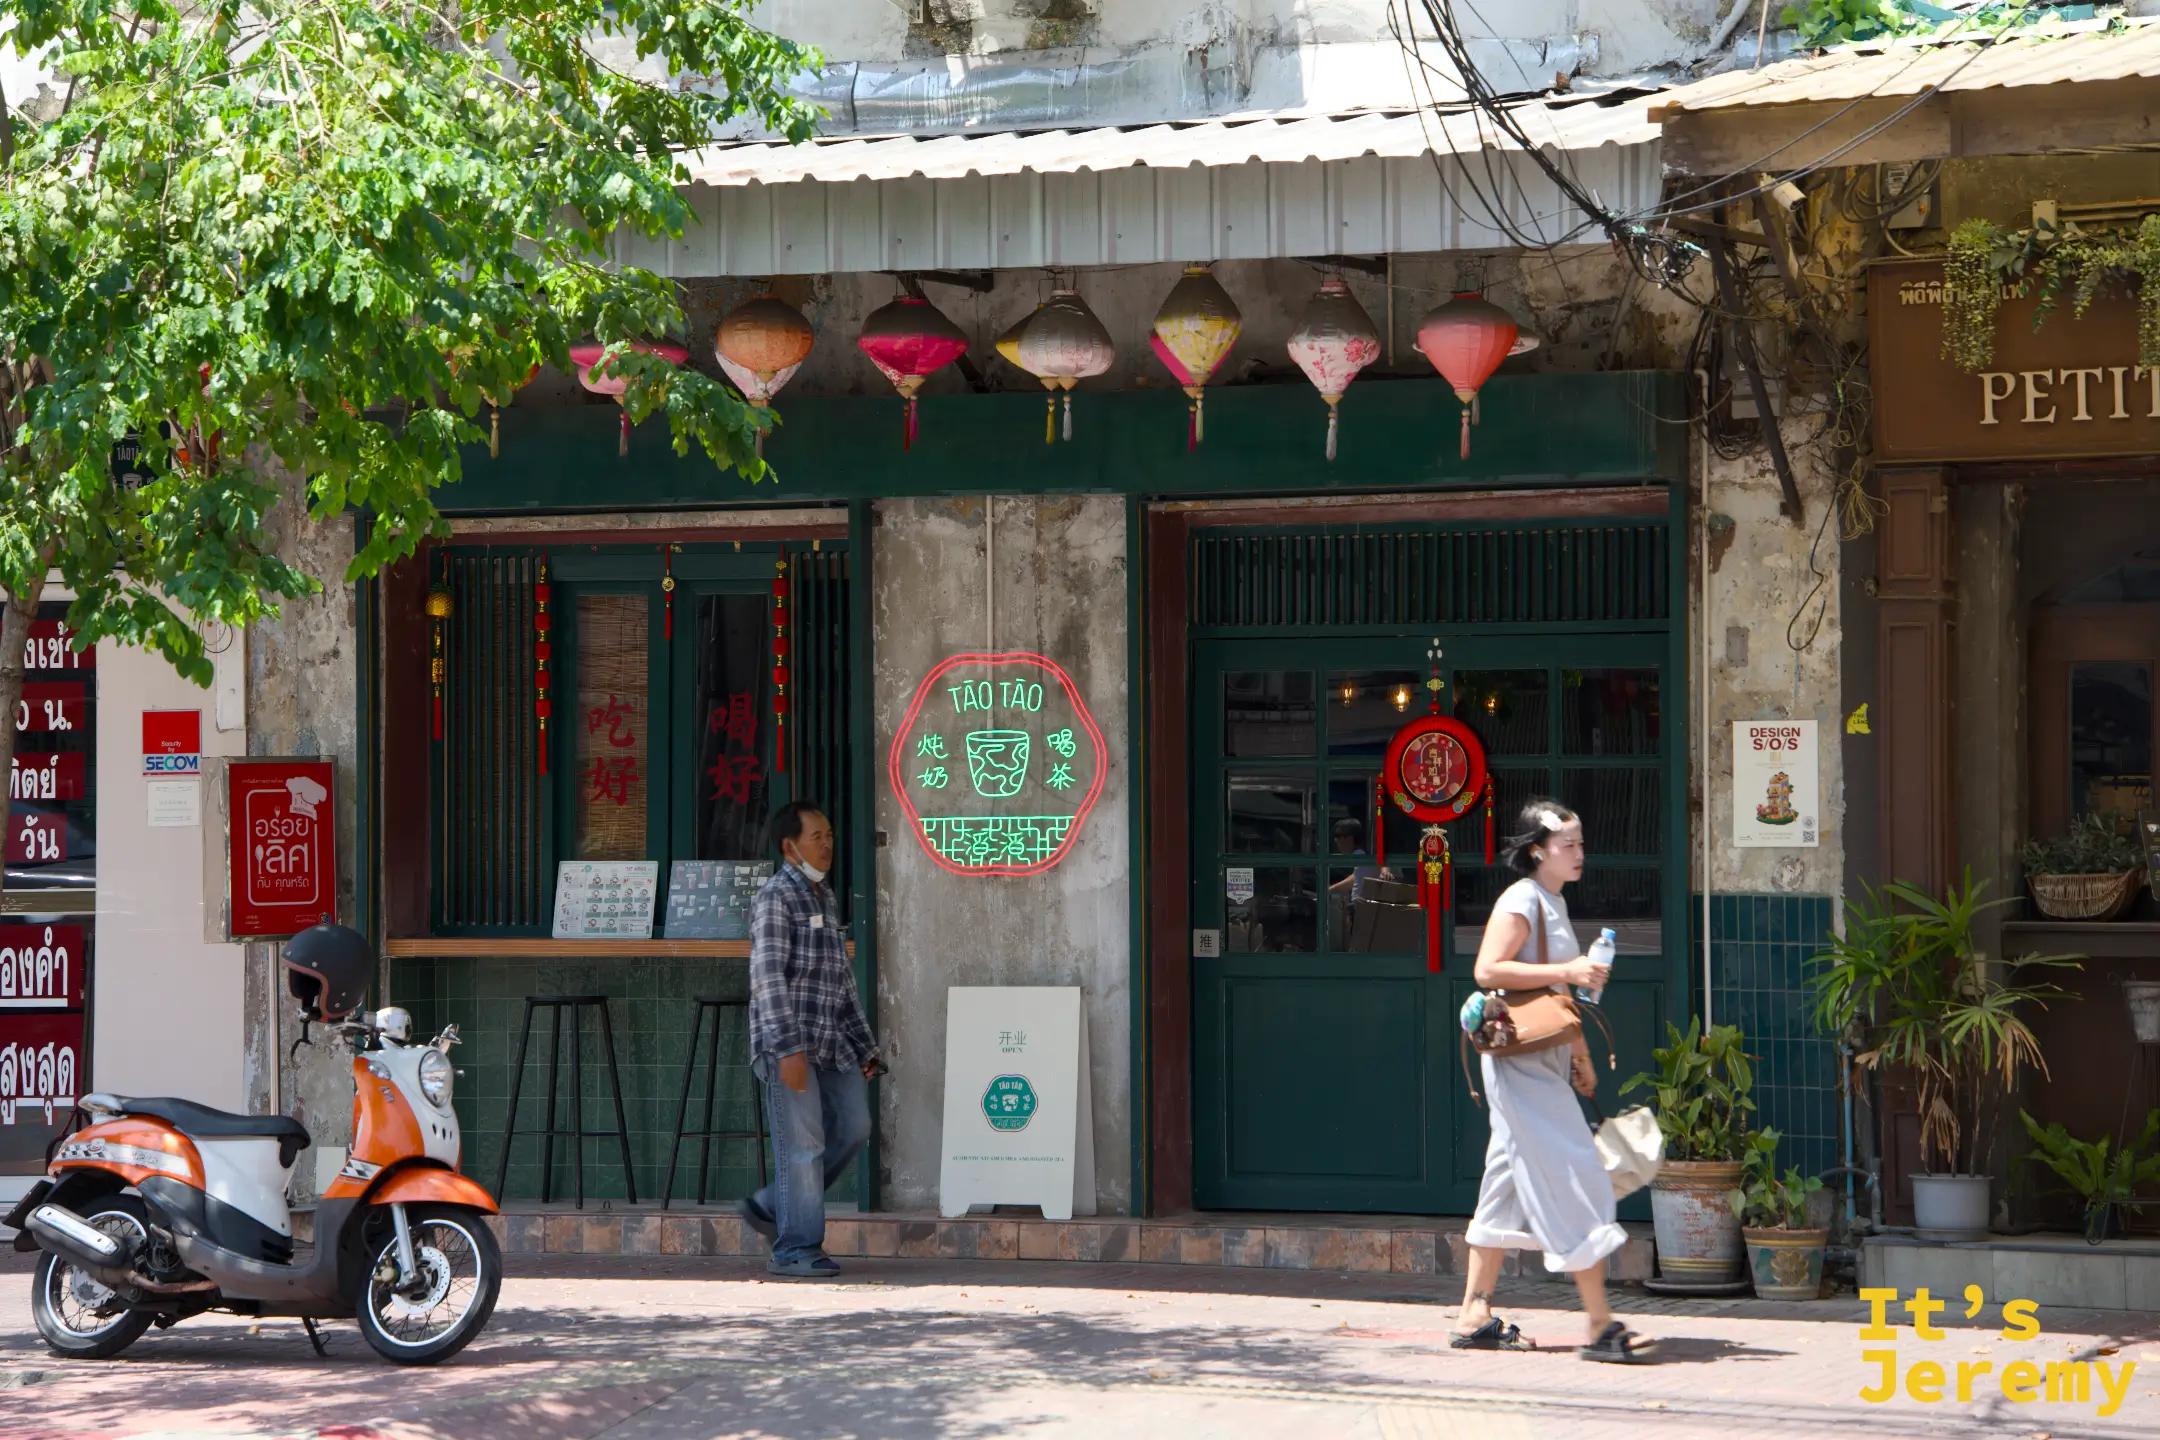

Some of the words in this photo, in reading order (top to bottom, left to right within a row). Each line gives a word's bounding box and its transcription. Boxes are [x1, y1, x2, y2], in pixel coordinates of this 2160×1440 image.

[947, 679, 993, 714] TĀO
[999, 678, 1043, 712] TĀO
[44, 699, 73, 731] น.
[161, 740, 182, 748] Security
[707, 692, 762, 805] 喝好
[1750, 727, 1801, 738] DESIGN
[1753, 738, 1798, 751] S/O/S
[146, 755, 198, 771] SECOM
[587, 694, 639, 806] 吃好
[917, 733, 949, 789] 炖奶
[1046, 728, 1077, 791] 喝茶
[20, 814, 60, 860] วัน
[255, 806, 309, 838] อร่อย
[257, 876, 272, 889] กับ
[1199, 933, 1213, 948] 推
[0, 926, 68, 996] องคำ
[998, 1030, 1027, 1046] 开业
[0, 1042, 75, 1126] สูงสุด
